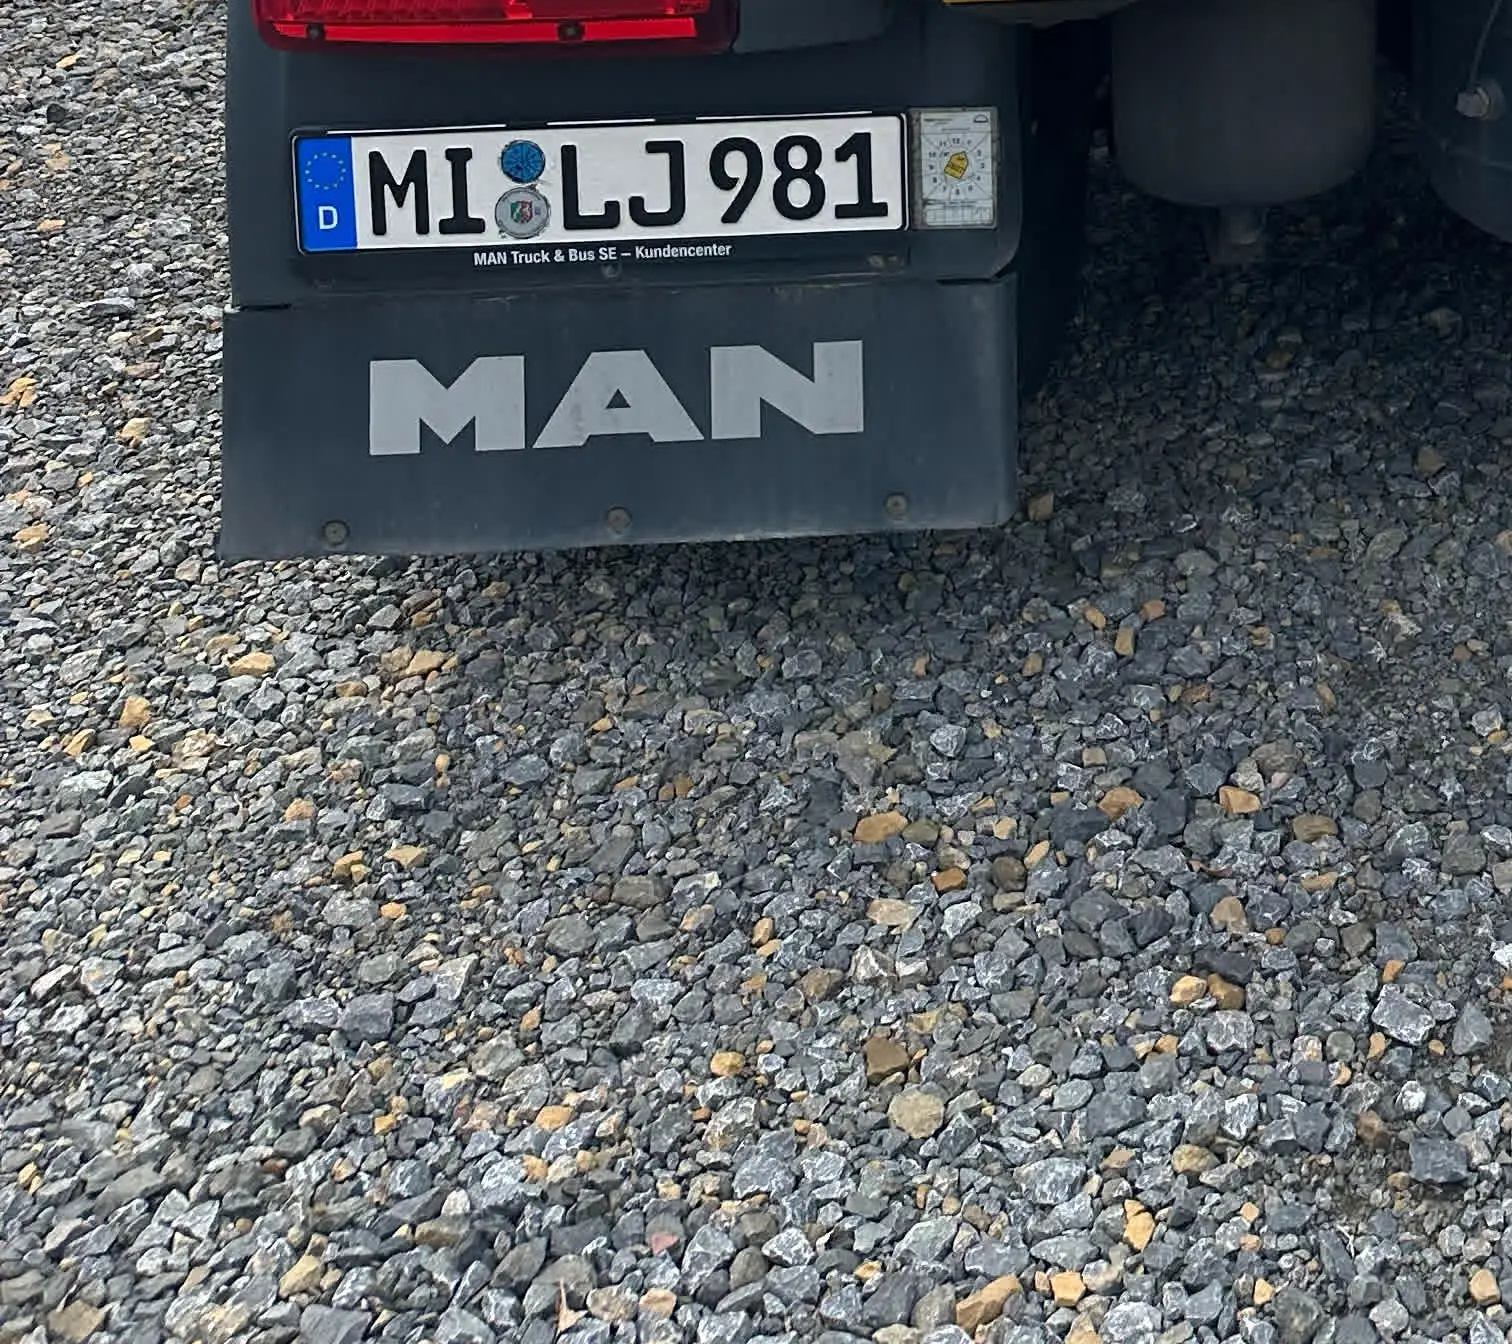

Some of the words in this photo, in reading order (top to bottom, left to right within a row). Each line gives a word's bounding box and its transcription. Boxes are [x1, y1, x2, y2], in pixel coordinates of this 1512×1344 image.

[368, 147, 487, 236] MI
[560, 140, 686, 230] LJ
[709, 132, 889, 224] 981
[318, 206, 338, 230] D
[474, 251, 507, 266] MAN
[511, 250, 550, 264] Truck
[554, 249, 565, 262] &
[568, 248, 595, 261] Bus
[599, 246, 617, 260] SE
[635, 243, 732, 259] Kundencenter
[369, 339, 865, 456] MAN
